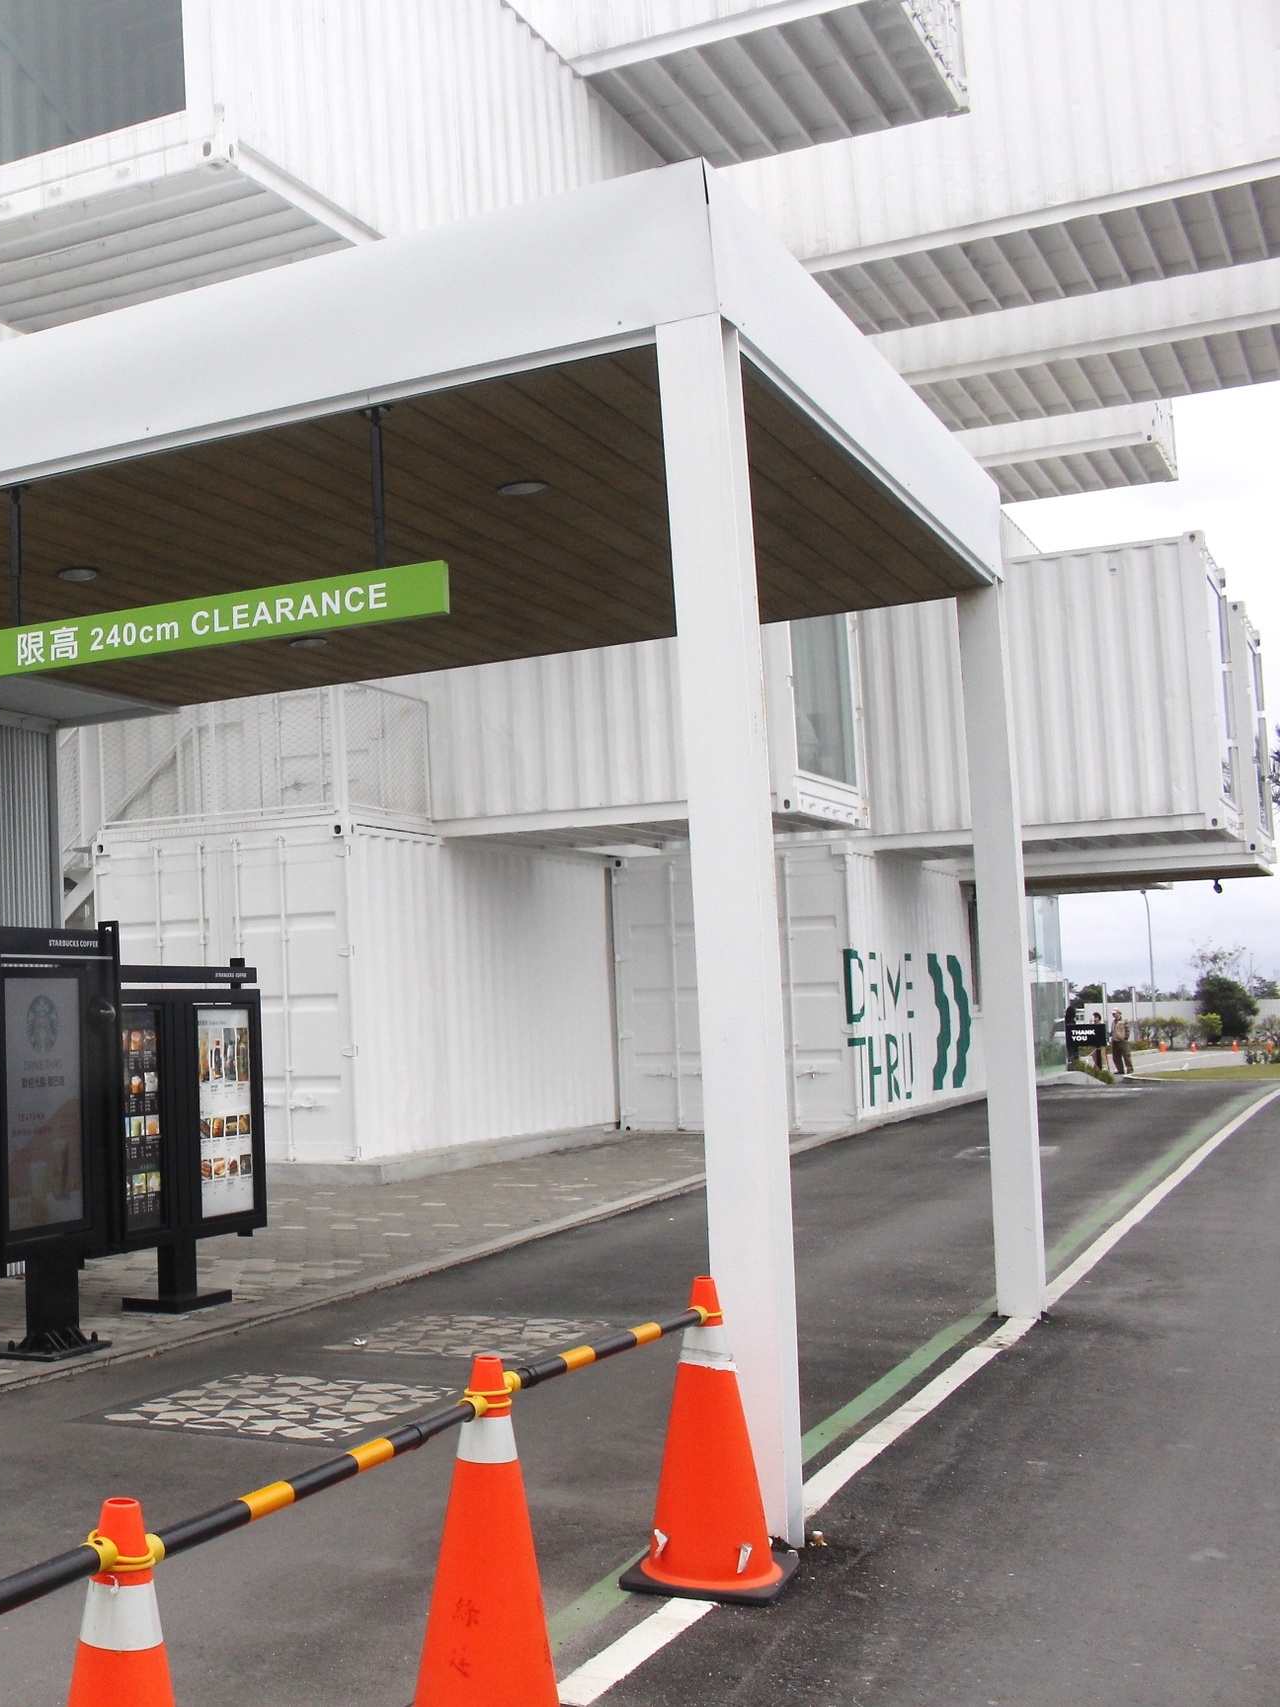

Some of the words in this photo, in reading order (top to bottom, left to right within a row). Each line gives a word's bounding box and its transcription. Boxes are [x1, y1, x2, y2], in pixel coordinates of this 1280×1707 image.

[17, 626, 78, 667] 限高
[90, 621, 179, 652] 240cm
[191, 582, 388, 636] CLEARANCE
[48, 939, 79, 948] STARBUCKS
[80, 940, 99, 948] COFFEE
[847, 1031, 914, 1109] THRU
